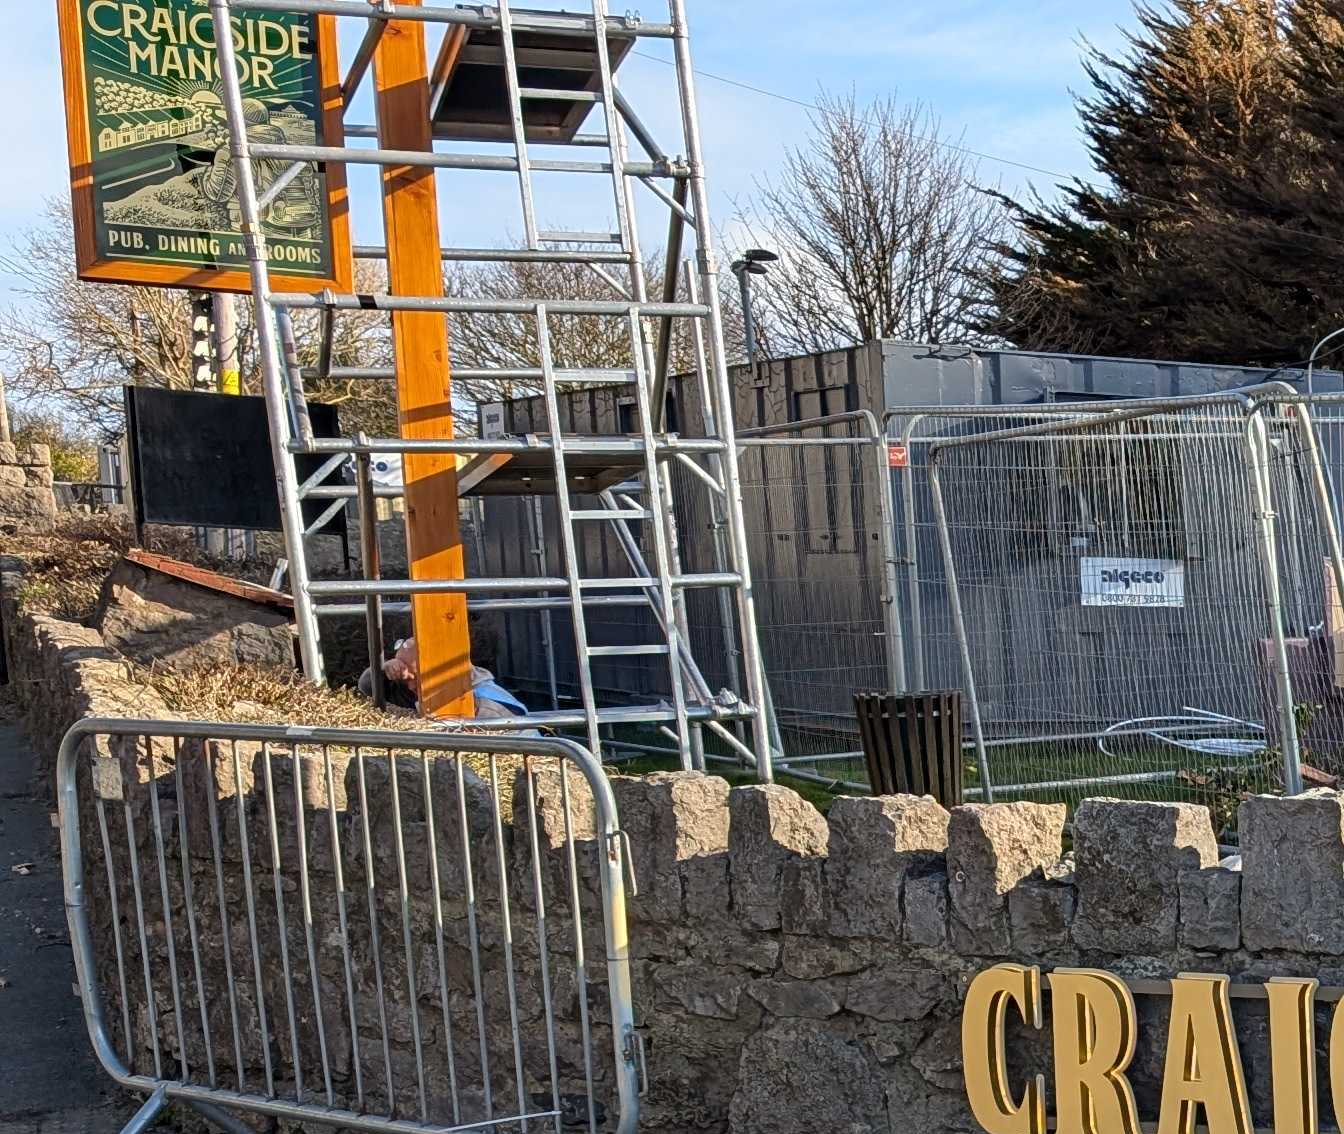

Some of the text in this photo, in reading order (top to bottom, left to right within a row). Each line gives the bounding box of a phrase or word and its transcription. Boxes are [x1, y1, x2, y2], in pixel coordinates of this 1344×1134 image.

[127, 41, 279, 90] MANOR
[158, 234, 221, 256] DINING
[228, 241, 248, 257] AN
[264, 244, 322, 265] ROOMS
